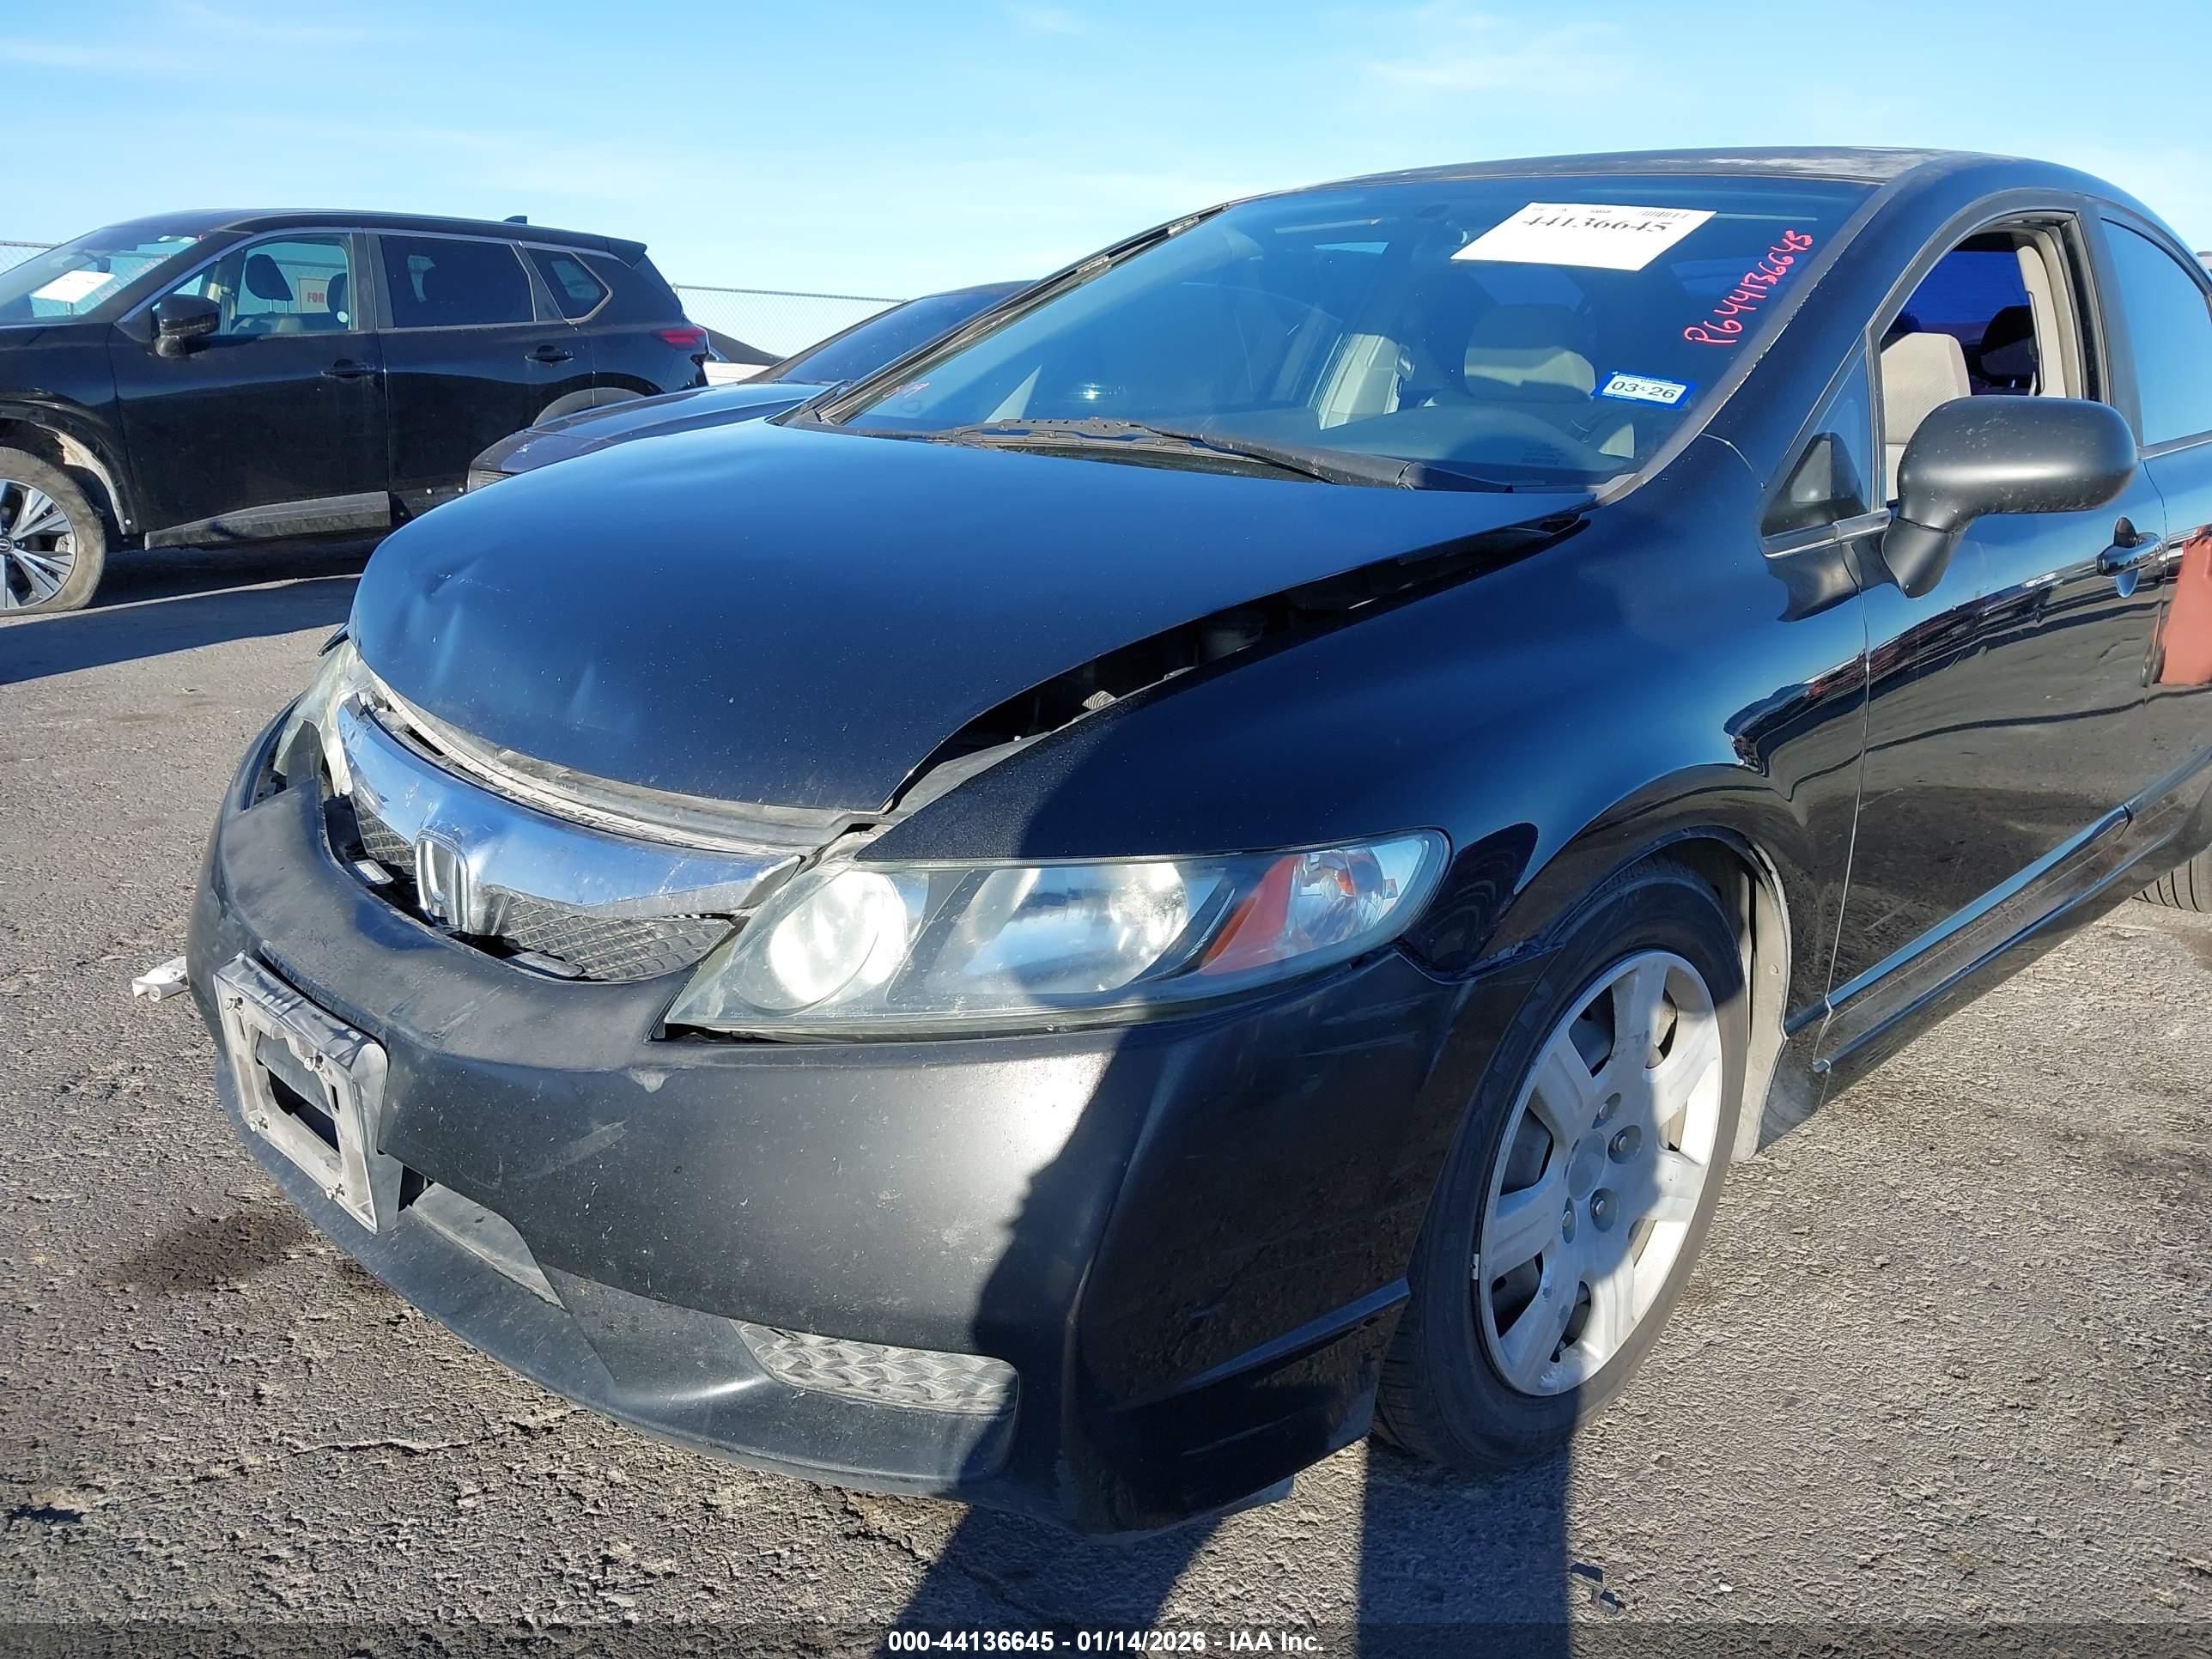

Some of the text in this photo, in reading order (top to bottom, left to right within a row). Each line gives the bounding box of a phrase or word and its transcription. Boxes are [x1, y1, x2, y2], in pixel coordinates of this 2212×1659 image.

[1522, 216, 1674, 232] 44136645
[1611, 380, 1639, 392] 03
[1648, 386, 1676, 398] 26
